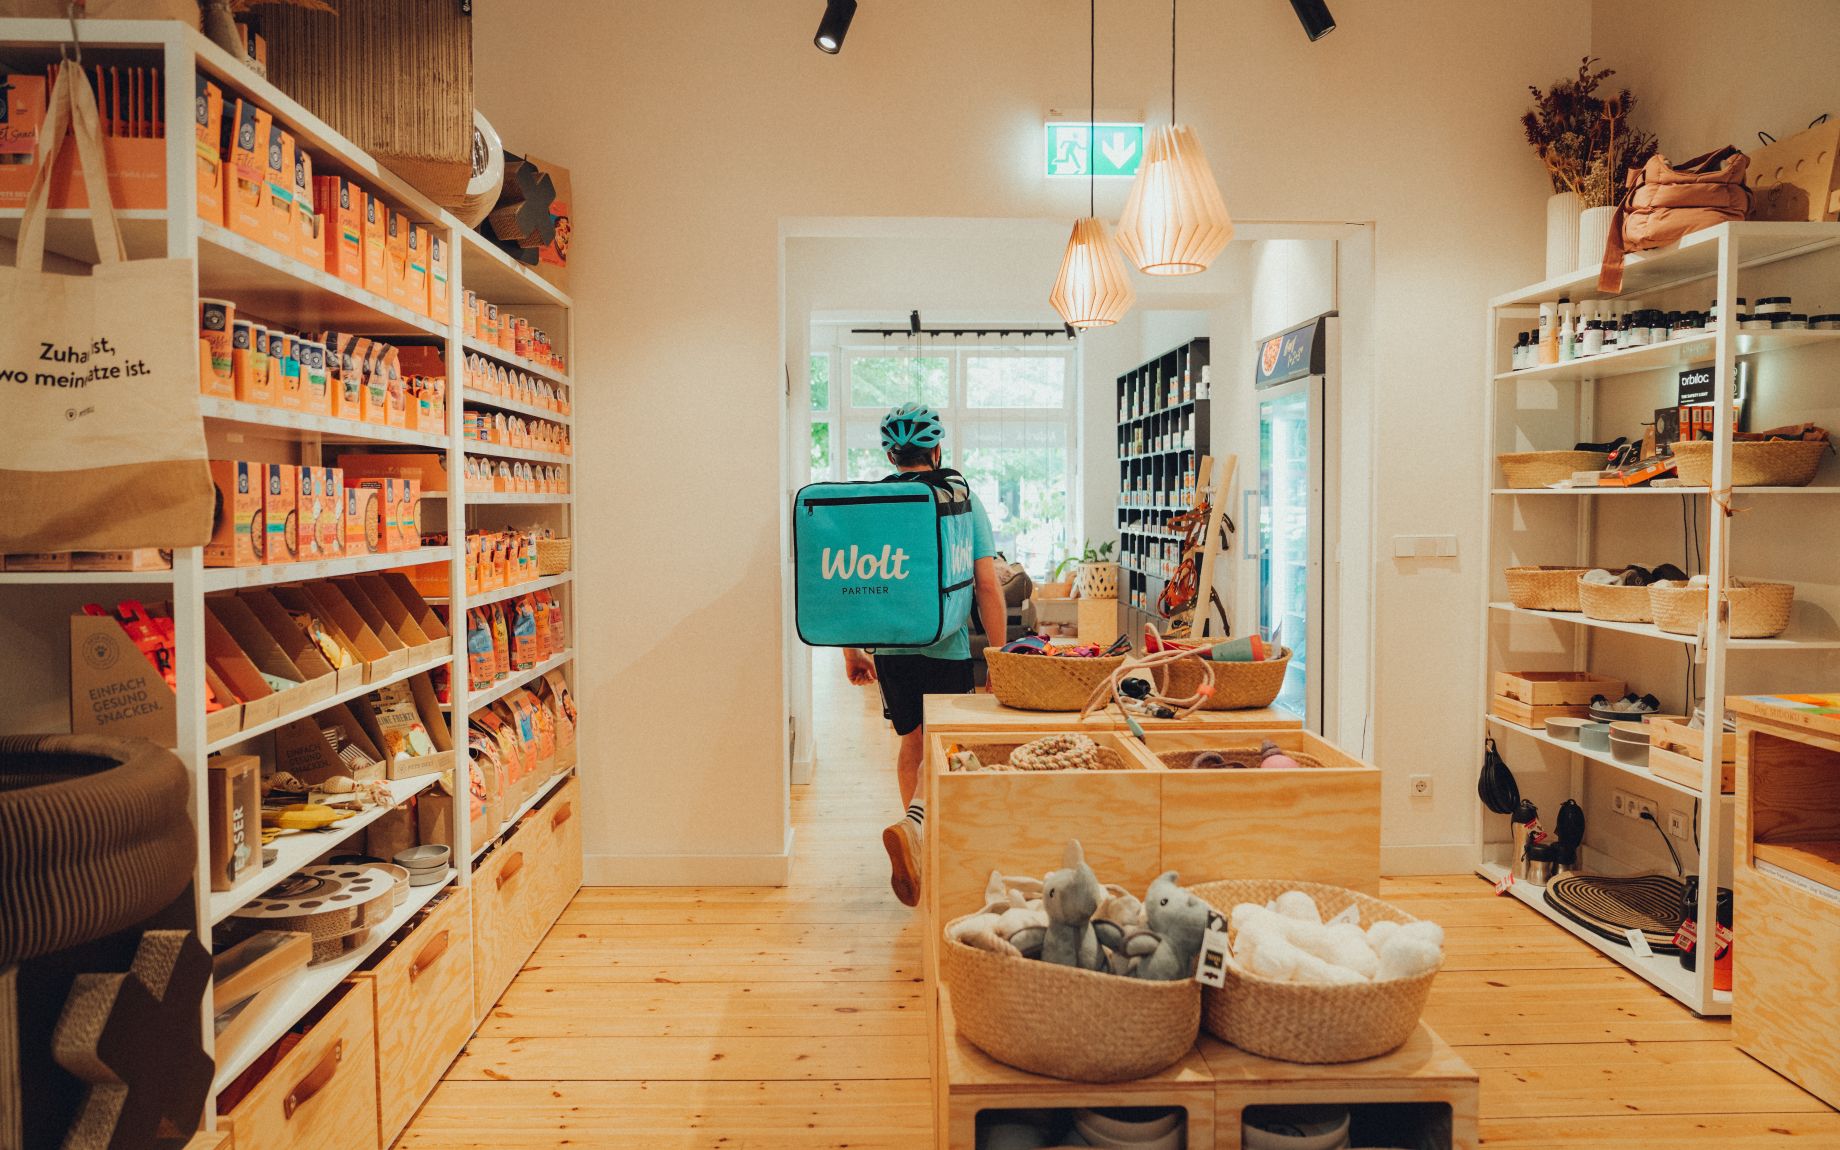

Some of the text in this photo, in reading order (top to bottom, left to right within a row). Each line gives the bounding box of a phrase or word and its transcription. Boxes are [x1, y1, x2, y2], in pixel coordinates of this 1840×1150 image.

[39, 342, 90, 363] Zuha
[35, 370, 87, 388] mein
[87, 365, 120, 383] atze
[125, 359, 151, 378] ist.
[1682, 373, 1709, 386] orbiloc
[821, 544, 910, 580] Wolt
[842, 586, 889, 595] PARTNER
[89, 677, 146, 700] EINFACH
[92, 690, 147, 713] GESUND
[96, 701, 163, 726] SNACKEN.
[392, 711, 415, 723] FRENZY
